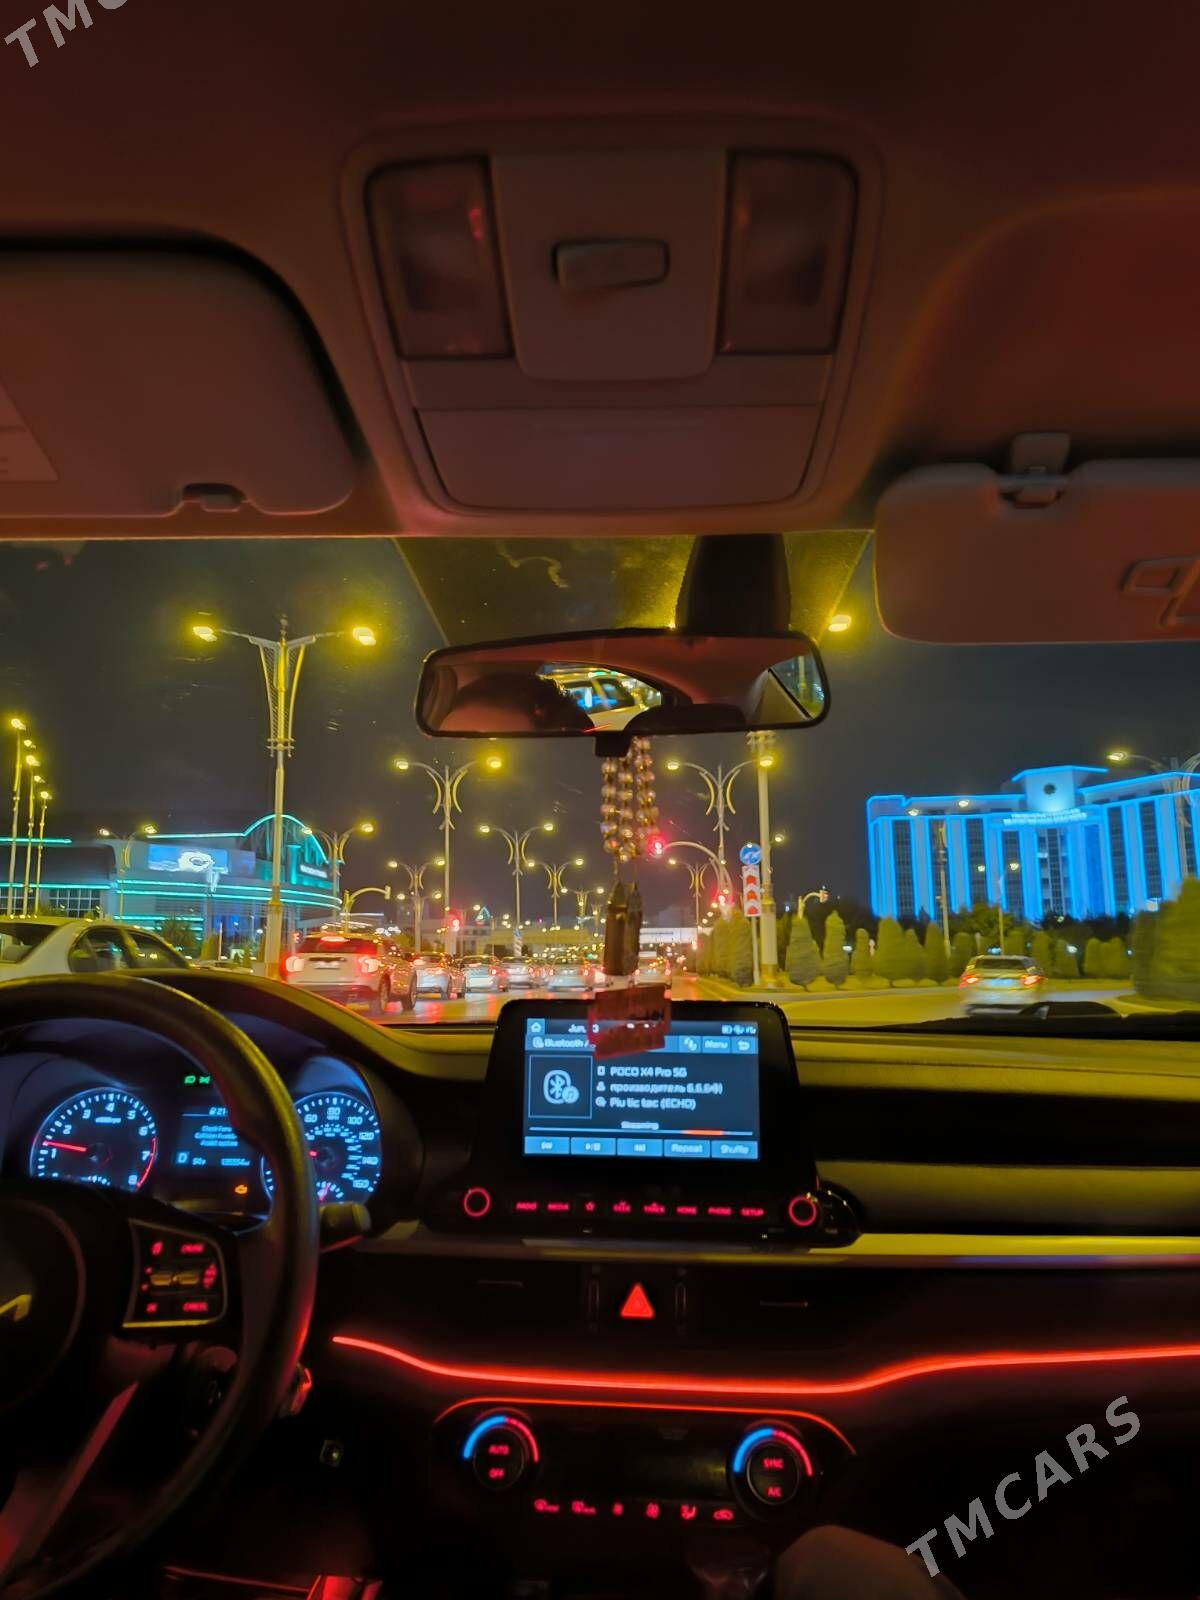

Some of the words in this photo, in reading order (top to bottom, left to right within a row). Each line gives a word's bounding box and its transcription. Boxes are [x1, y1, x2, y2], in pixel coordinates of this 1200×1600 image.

[544, 1039, 583, 1048] Bluetooth
[704, 1040, 728, 1048] Menu
[610, 1067, 639, 1077] POCO
[640, 1067, 653, 1077] X4
[655, 1068, 672, 1077] Pro
[673, 1068, 687, 1077] 5G
[105, 1102, 115, 1112] 4
[82, 1109, 91, 1119] 3
[127, 1110, 136, 1120] 5
[304, 1114, 318, 1123] 60
[347, 1116, 363, 1125] 100
[63, 1124, 72, 1134] 2
[138, 1125, 148, 1136] 6
[51, 1148, 57, 1158] 1
[672, 1144, 703, 1154] Repeat
[720, 1144, 749, 1154] Shuffle
[142, 1151, 151, 1160] 7
[128, 1175, 138, 1185] 8
[741, 1208, 764, 1217] SETUP
[763, 1458, 784, 1468] SYNC
